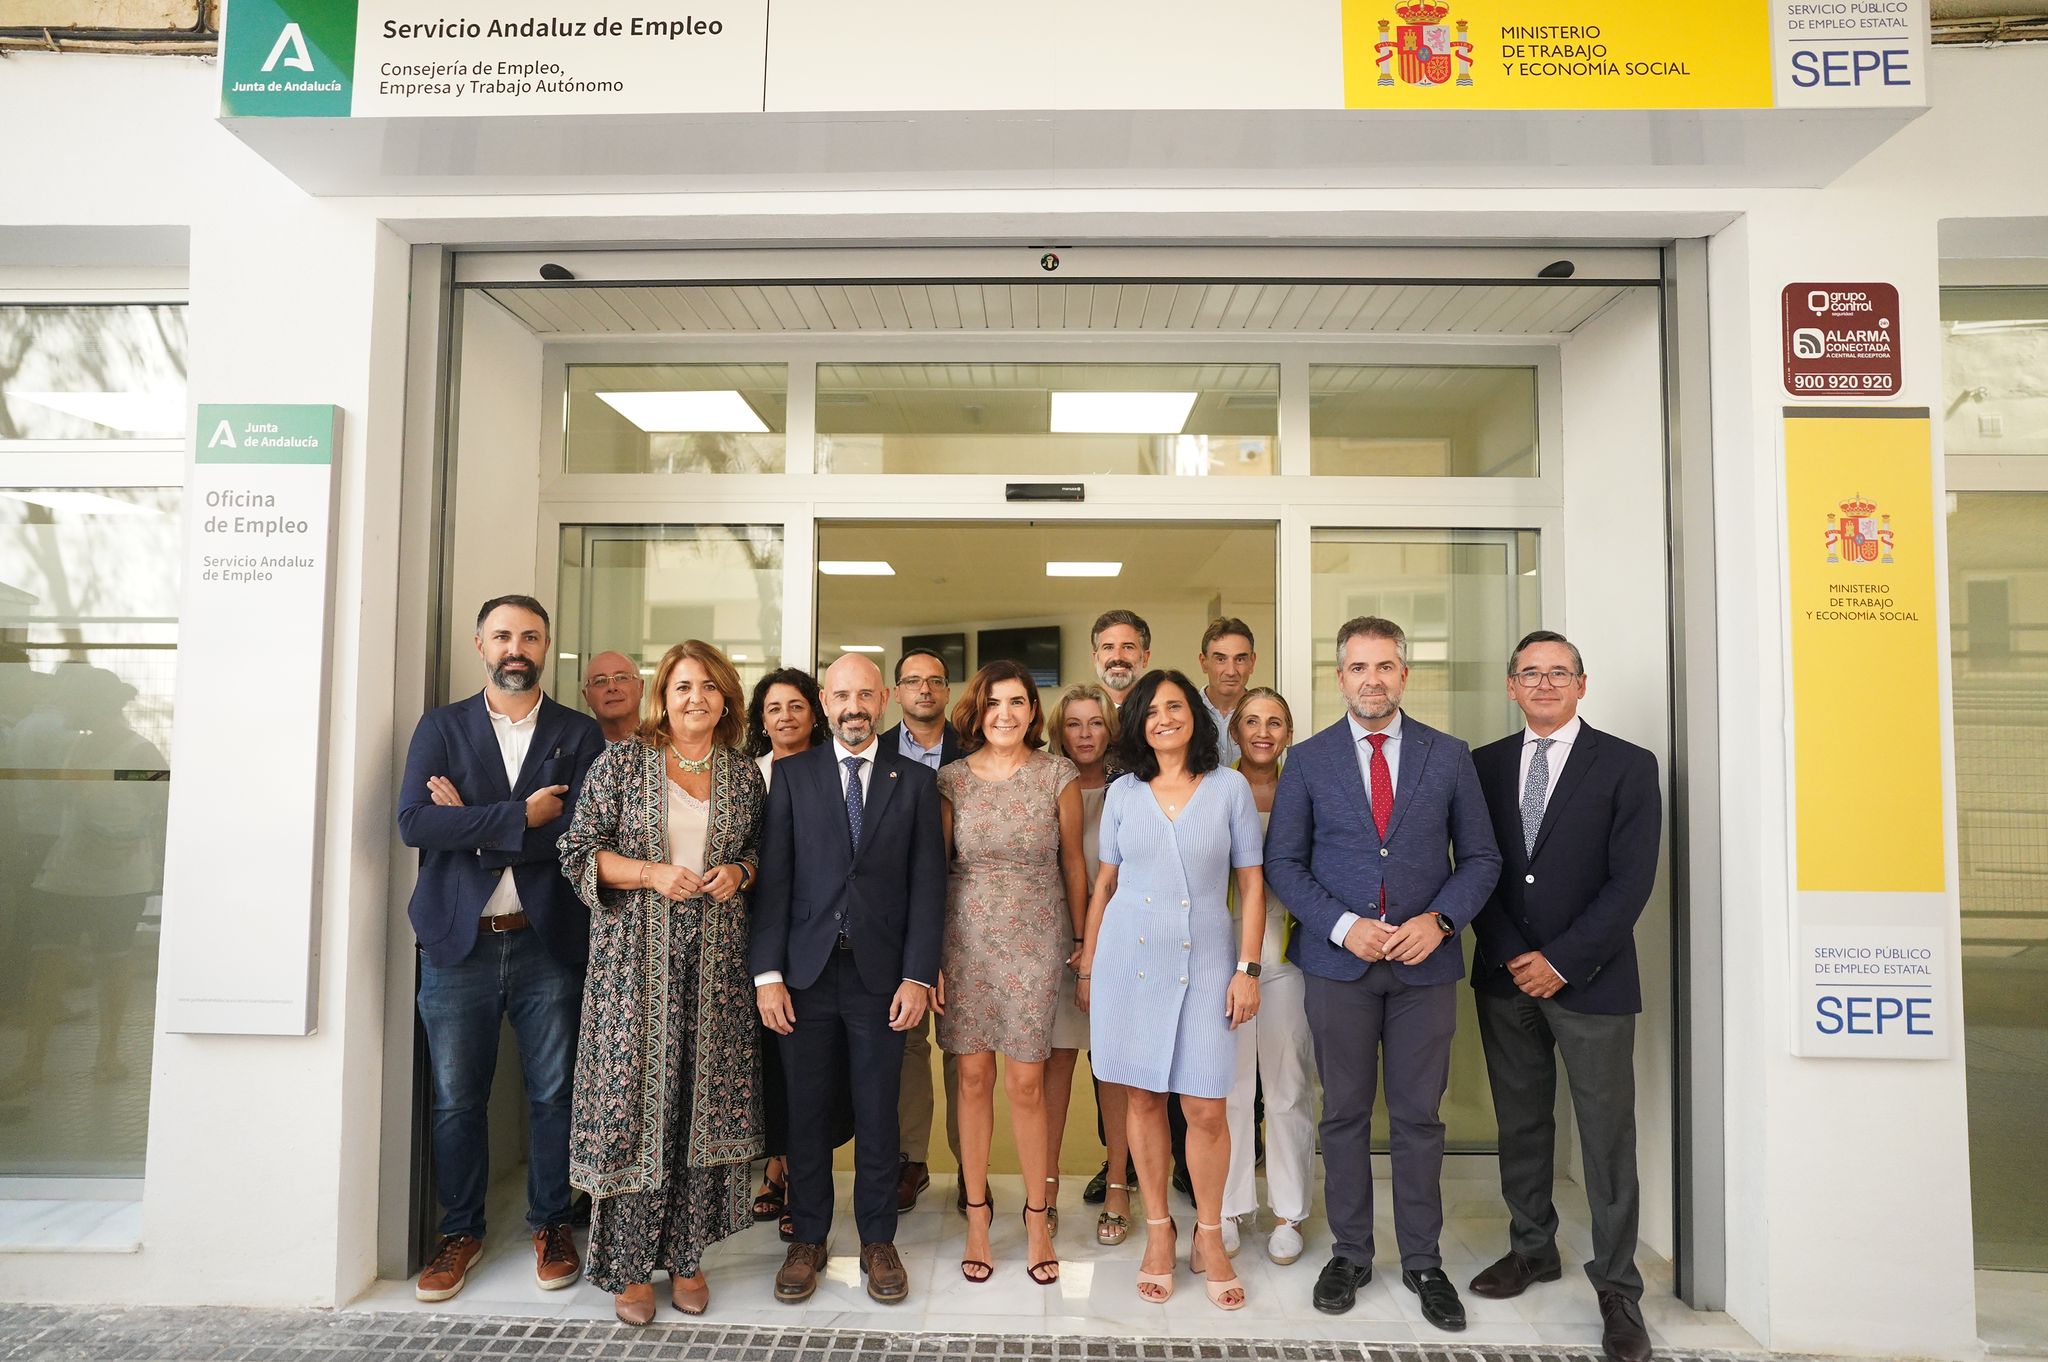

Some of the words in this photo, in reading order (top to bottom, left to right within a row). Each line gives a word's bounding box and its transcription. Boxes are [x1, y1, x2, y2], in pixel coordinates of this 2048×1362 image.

[1788, 4, 1846, 15] SERVICIO
[1851, 1, 1908, 14] PÚBLICO
[383, 19, 481, 40] Servicio
[487, 18, 586, 38] Andaluz
[593, 17, 623, 37] de
[630, 16, 723, 39] Empleo
[1789, 20, 1805, 29] DE
[1809, 19, 1856, 29] EMPLEO
[1860, 18, 1908, 28] ESTATAL
[1502, 26, 1600, 39] MINISTERIO
[1503, 44, 1527, 58] DE
[1529, 44, 1607, 61] TRABAJO
[381, 61, 466, 80] Consejería
[473, 61, 492, 75] de
[497, 61, 565, 79] Empleo,
[1503, 63, 1512, 76] Y
[1520, 59, 1620, 76] ECONOMÍA
[1626, 61, 1690, 75] SOCIAL
[1792, 50, 1911, 87] SEPE
[232, 81, 264, 93] Junta
[268, 80, 281, 93] de
[284, 79, 341, 93] Andalucía
[380, 80, 451, 98] Empresa
[456, 83, 465, 97] y
[470, 79, 532, 97] Trabajo
[536, 78, 623, 94] Autónomo
[1830, 292, 1866, 302] grupo
[1831, 301, 1872, 311] control
[1826, 330, 1890, 342] ALARMA
[1795, 376, 1824, 388] 900
[1829, 376, 1858, 388] 920
[1863, 376, 1892, 388] 920
[245, 423, 278, 433] Junta
[244, 436, 258, 447] de
[261, 436, 319, 447] Andalucía
[206, 490, 275, 507] Oficina
[204, 516, 228, 533] de
[234, 516, 308, 537] Empleo
[204, 556, 257, 567] Servicio
[261, 556, 314, 567] Andaluz
[203, 570, 218, 581] de
[223, 570, 273, 583] Empleo
[1829, 584, 1889, 593] MINISTERIO
[1830, 598, 1843, 606] DE
[1846, 599, 1893, 609] TRABAJO
[1806, 611, 1813, 620] Y
[1816, 610, 1876, 620] ECONOMÍA
[1880, 612, 1918, 621] SOCIAL
[1815, 948, 1870, 958] SERVICIO
[1876, 946, 1931, 959] PÚBLICO
[1815, 964, 1830, 973] DE
[1834, 964, 1880, 974] EMPLEO
[1884, 965, 1932, 974] ESTATAL
[1816, 996, 1933, 1035] SEPE
